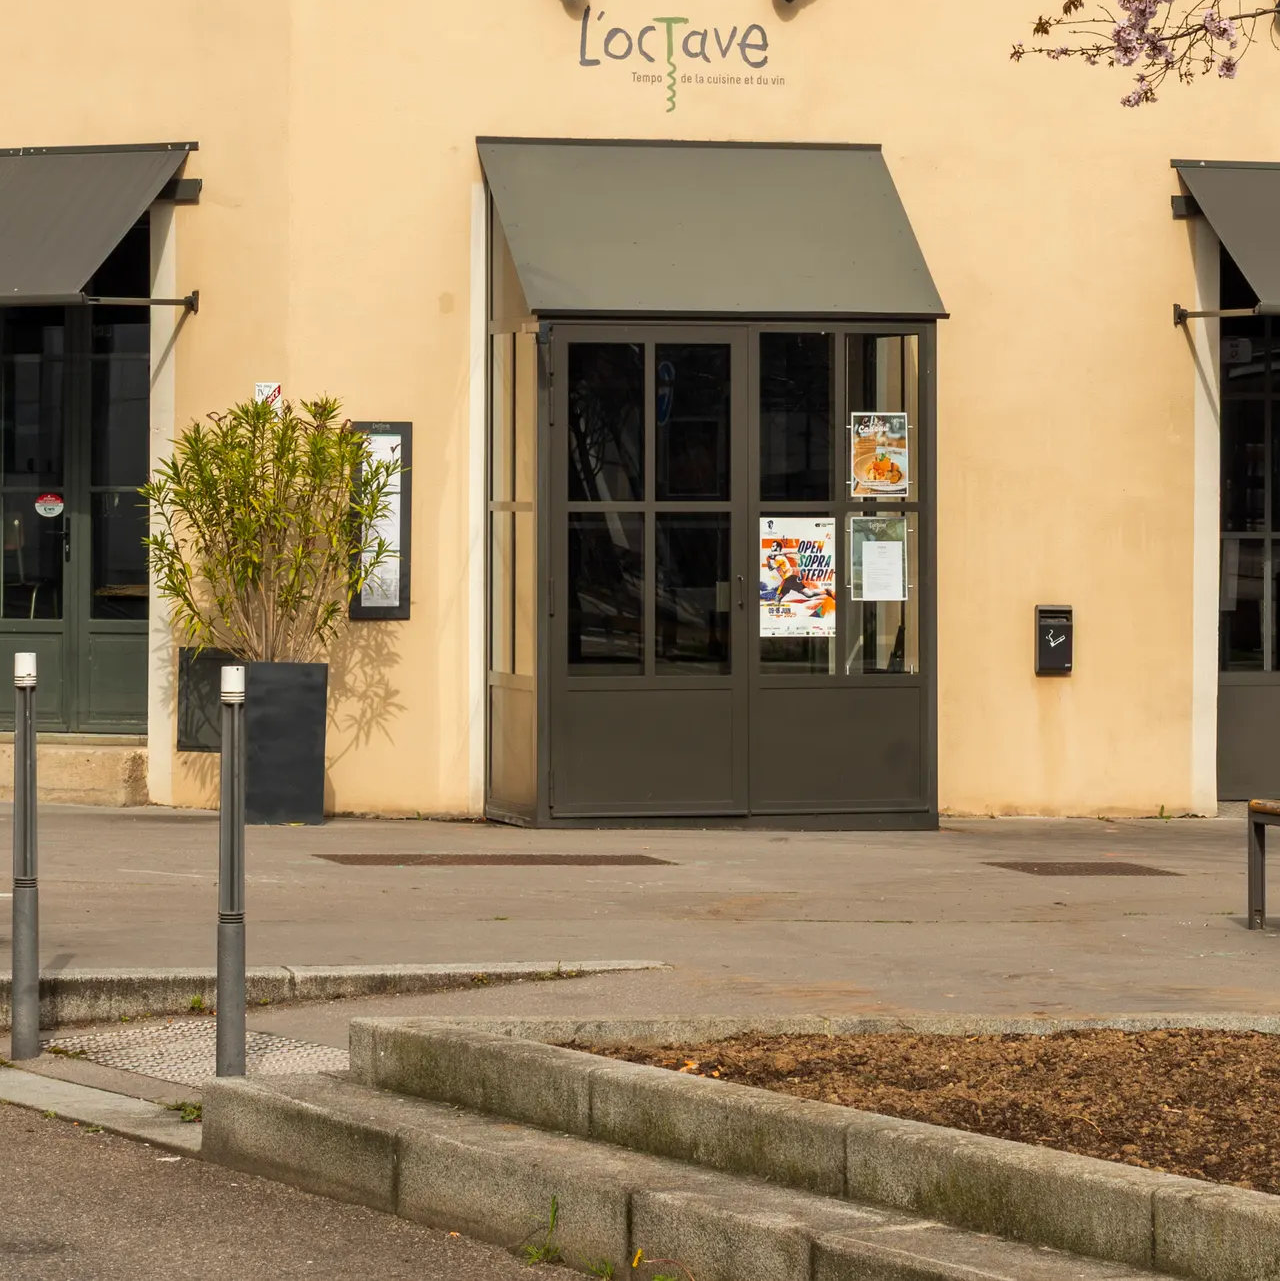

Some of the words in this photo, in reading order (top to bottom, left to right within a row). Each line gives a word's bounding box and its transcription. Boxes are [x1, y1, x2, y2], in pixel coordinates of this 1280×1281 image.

[631, 72, 663, 85] Tempo
[680, 73, 692, 84] de
[695, 73, 704, 84] la
[706, 74, 741, 85] cuisine
[744, 74, 754, 85] et
[756, 74, 769, 86] du
[771, 74, 785, 86] vin
[797, 540, 825, 554] OPEN
[797, 554, 832, 568] SOPRA
[797, 568, 835, 582] STERIA
